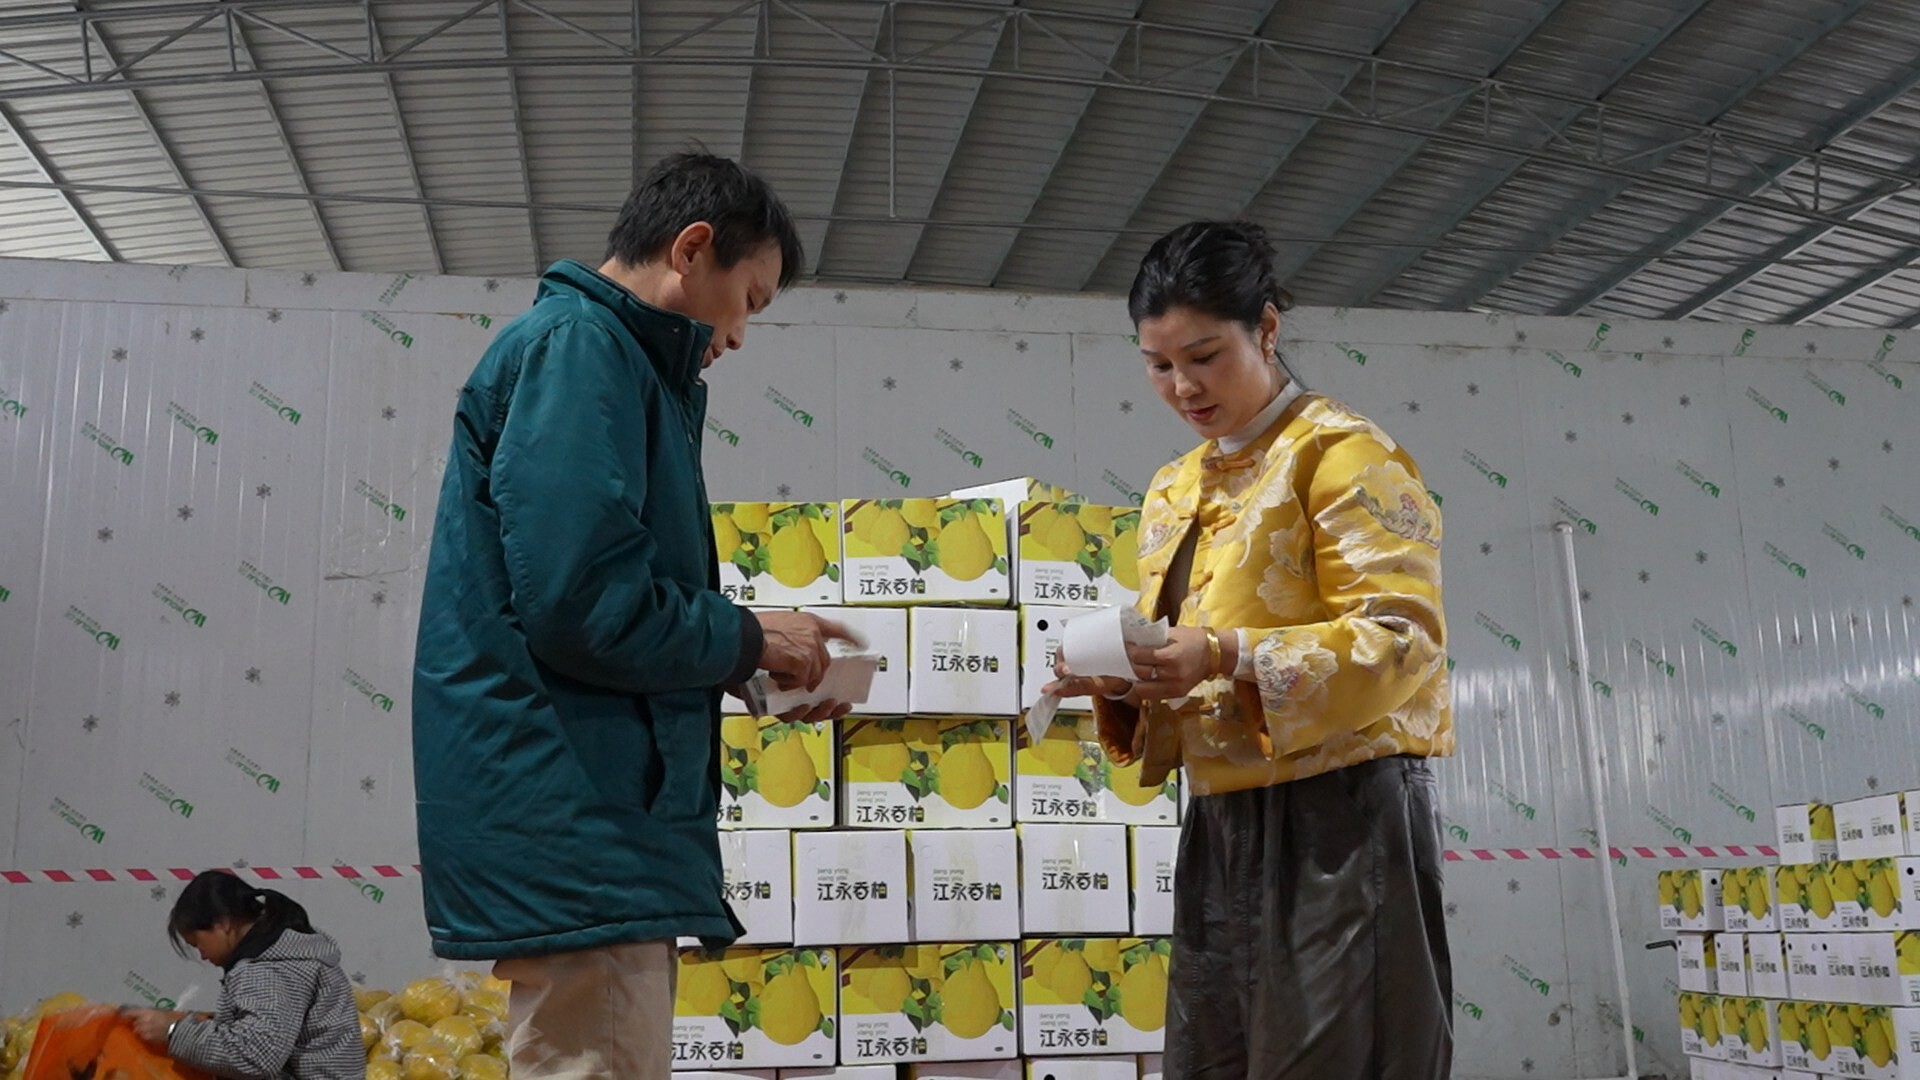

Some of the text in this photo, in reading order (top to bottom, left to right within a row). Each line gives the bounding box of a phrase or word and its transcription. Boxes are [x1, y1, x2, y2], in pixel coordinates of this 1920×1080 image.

[722, 585, 756, 602] 香柚
[859, 578, 926, 595] 江永香柚
[1034, 582, 1098, 601] 江永香柚
[931, 654, 999, 673] 江永香柚
[857, 805, 925, 823] 江永香柚
[1032, 799, 1097, 817] 江永香柚
[721, 881, 771, 901] 永香柚
[817, 880, 888, 901] 江永香柚
[1042, 872, 1109, 891] 江永香柚
[933, 882, 1002, 901] 江永香柚
[857, 1037, 927, 1057] 江永香柚
[1040, 1028, 1108, 1047] 江永香柚
[671, 1041, 744, 1061] 江永香柚
